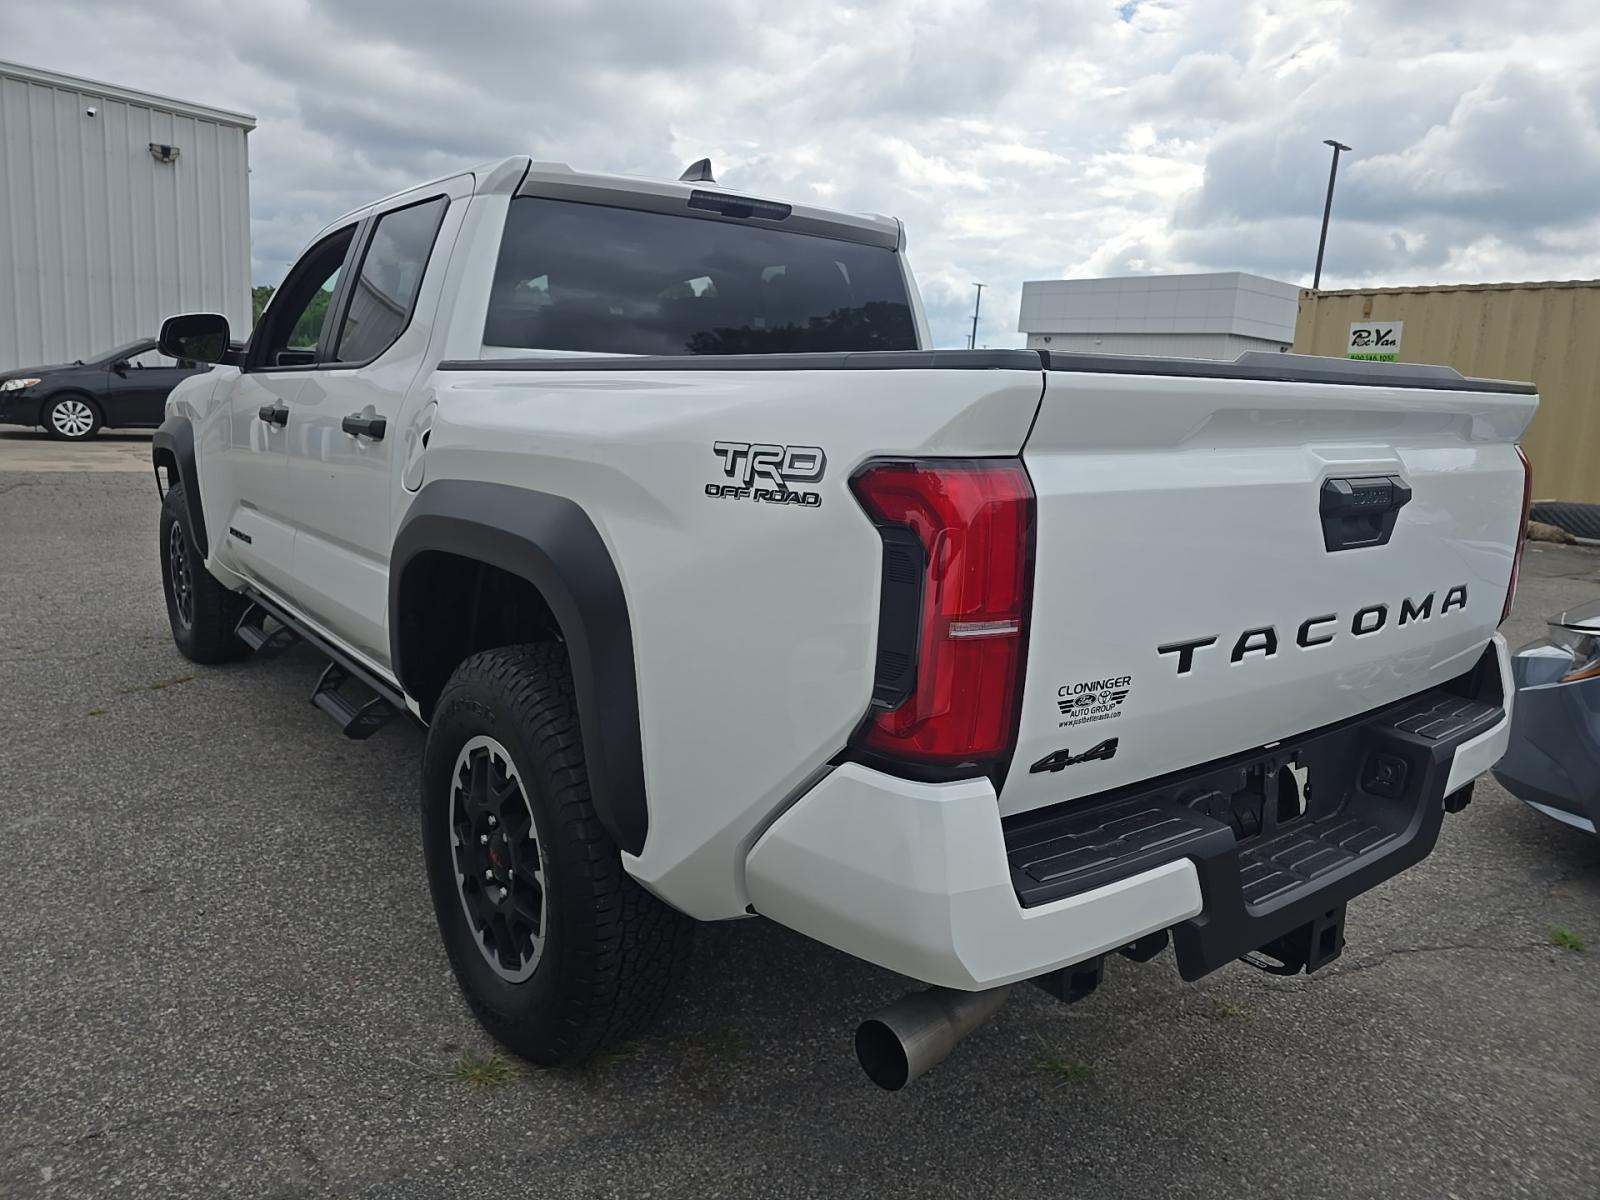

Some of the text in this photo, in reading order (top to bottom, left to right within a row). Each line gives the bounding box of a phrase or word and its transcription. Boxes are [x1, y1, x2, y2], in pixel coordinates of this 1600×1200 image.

[713, 440, 828, 493] TRD
[704, 483, 822, 508] OFF ROAD
[1157, 583, 1468, 675] TACOMA
[1057, 675, 1132, 697] CLONINGER
[1070, 703, 1116, 718] AUTO GROUP
